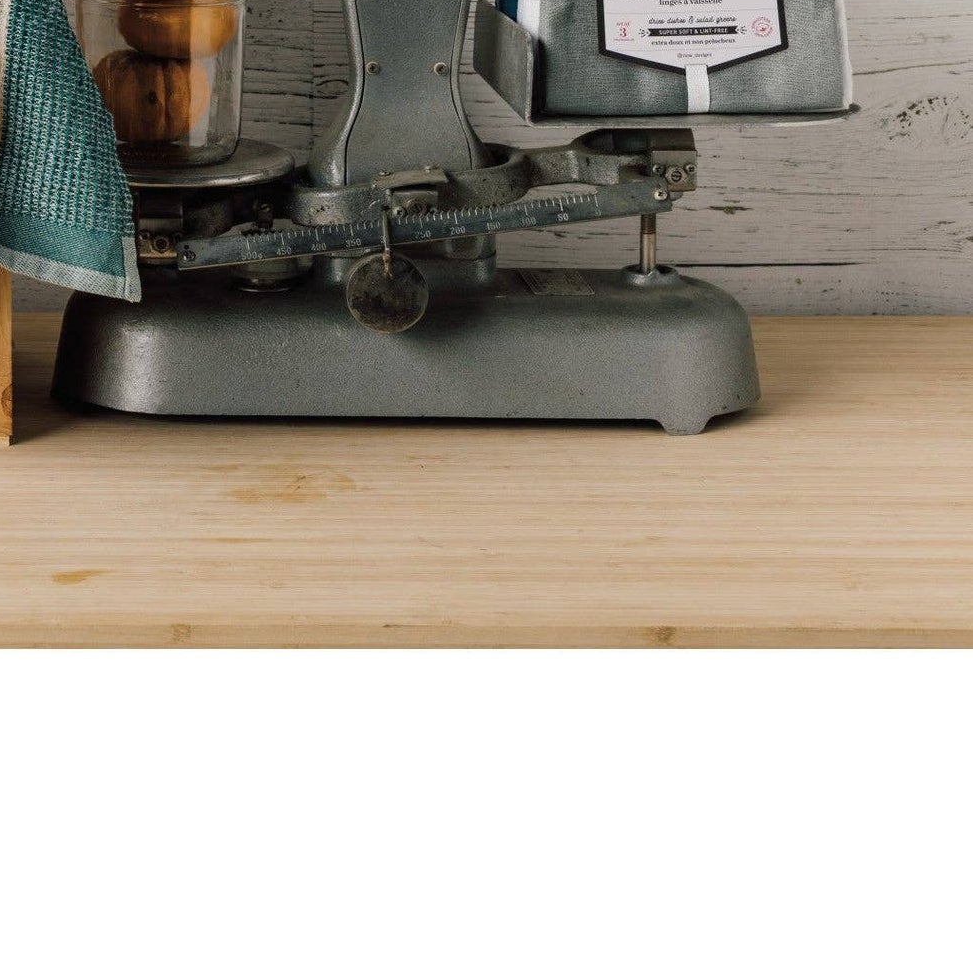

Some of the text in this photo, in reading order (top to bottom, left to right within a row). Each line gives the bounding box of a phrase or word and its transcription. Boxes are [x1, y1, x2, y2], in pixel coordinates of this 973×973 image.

[619, 28, 627, 37] 3
[276, 247, 292, 256] 450
[345, 238, 362, 247] 350
[450, 225, 466, 235] 200
